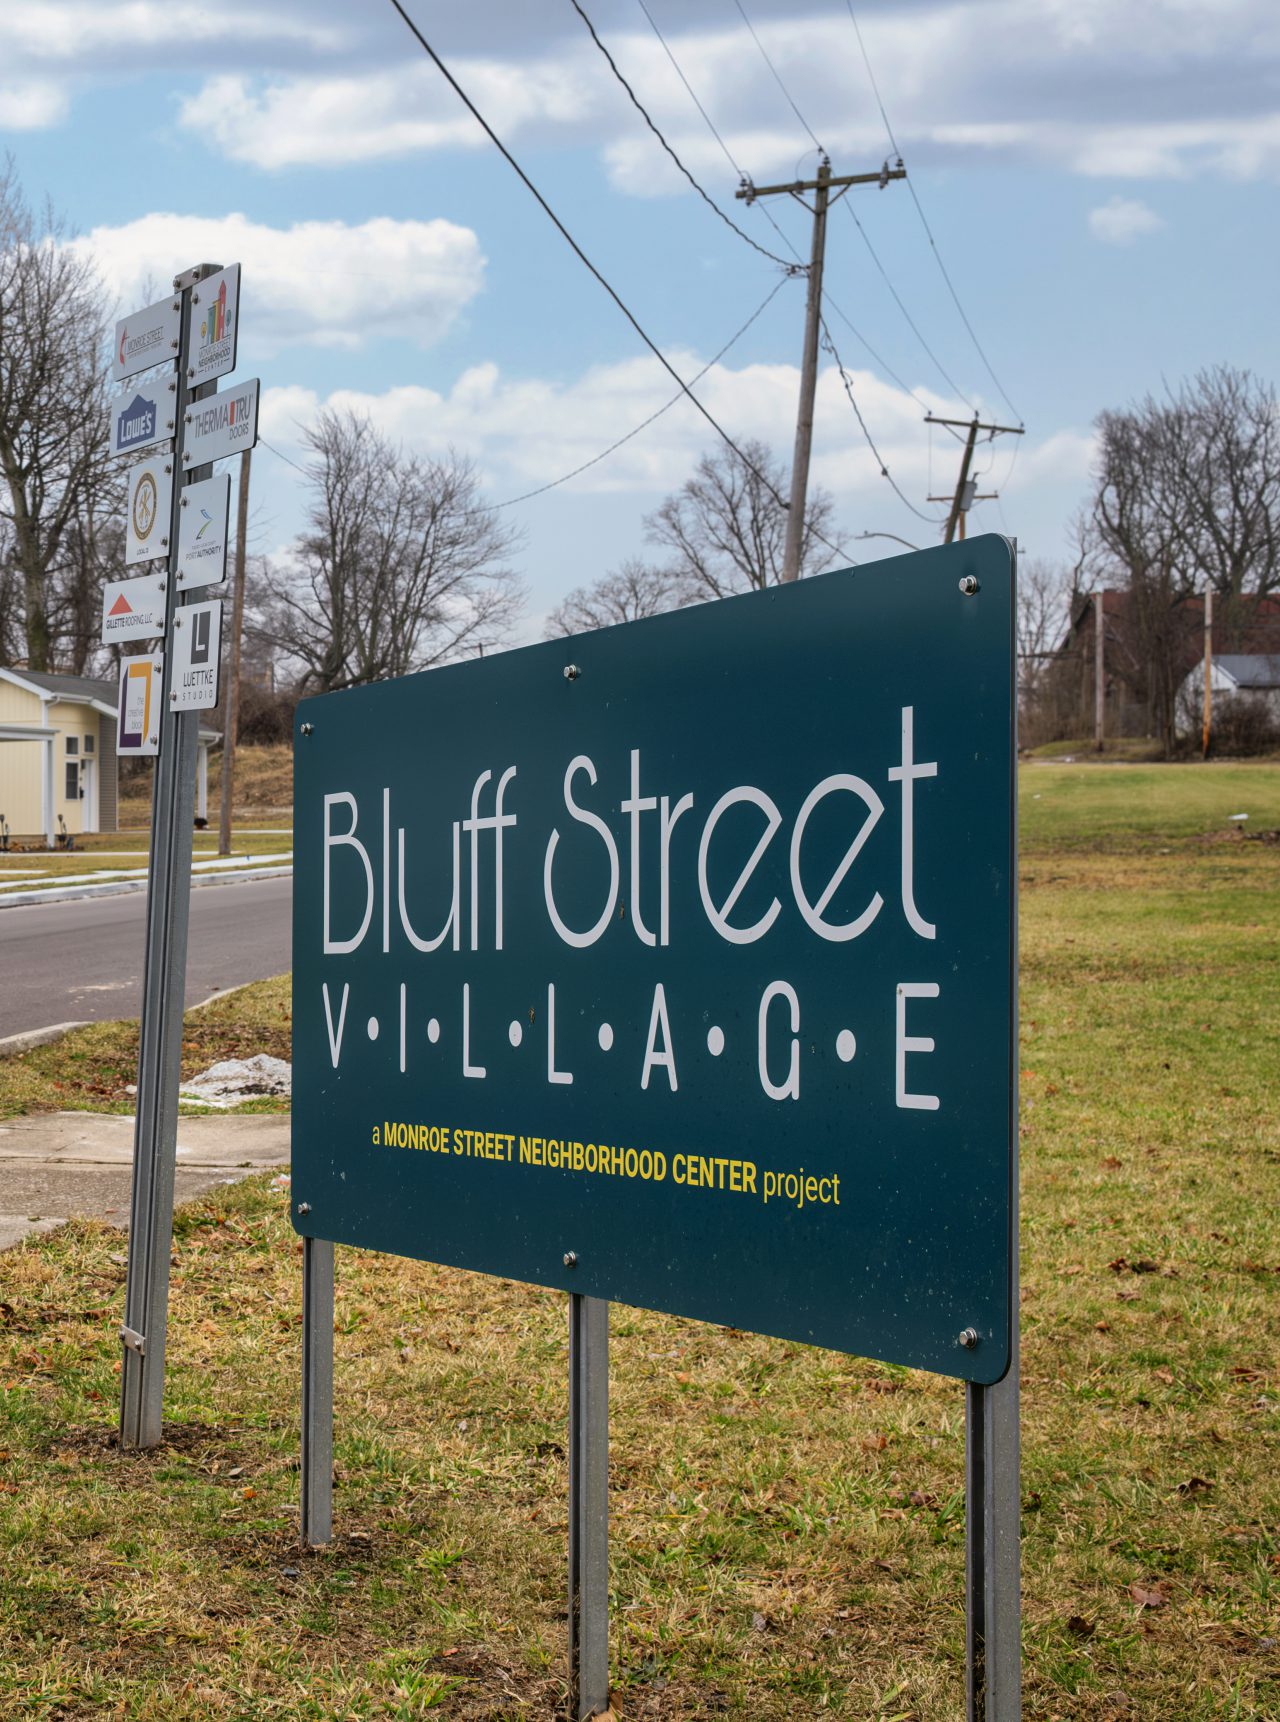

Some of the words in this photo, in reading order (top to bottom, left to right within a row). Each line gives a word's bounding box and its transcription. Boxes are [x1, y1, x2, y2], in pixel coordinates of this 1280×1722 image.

[198, 347, 231, 367] NEIGHBORHOOD
[121, 410, 152, 443] LOWE'S
[229, 421, 249, 440] DOORS
[106, 617, 125, 629] GILLETTE
[144, 612, 153, 624] LLC
[183, 669, 214, 687] LUETTKE
[182, 689, 213, 701] STUDIO
[323, 765, 517, 954] Bluff
[544, 705, 938, 948] Street
[372, 1125, 380, 1144] a
[384, 1121, 450, 1154] MONROE
[453, 1129, 515, 1162] STREET
[519, 1136, 667, 1181] NEIGHBORHOOD
[672, 1153, 757, 1194] CENTER
[763, 1167, 841, 1208] project
